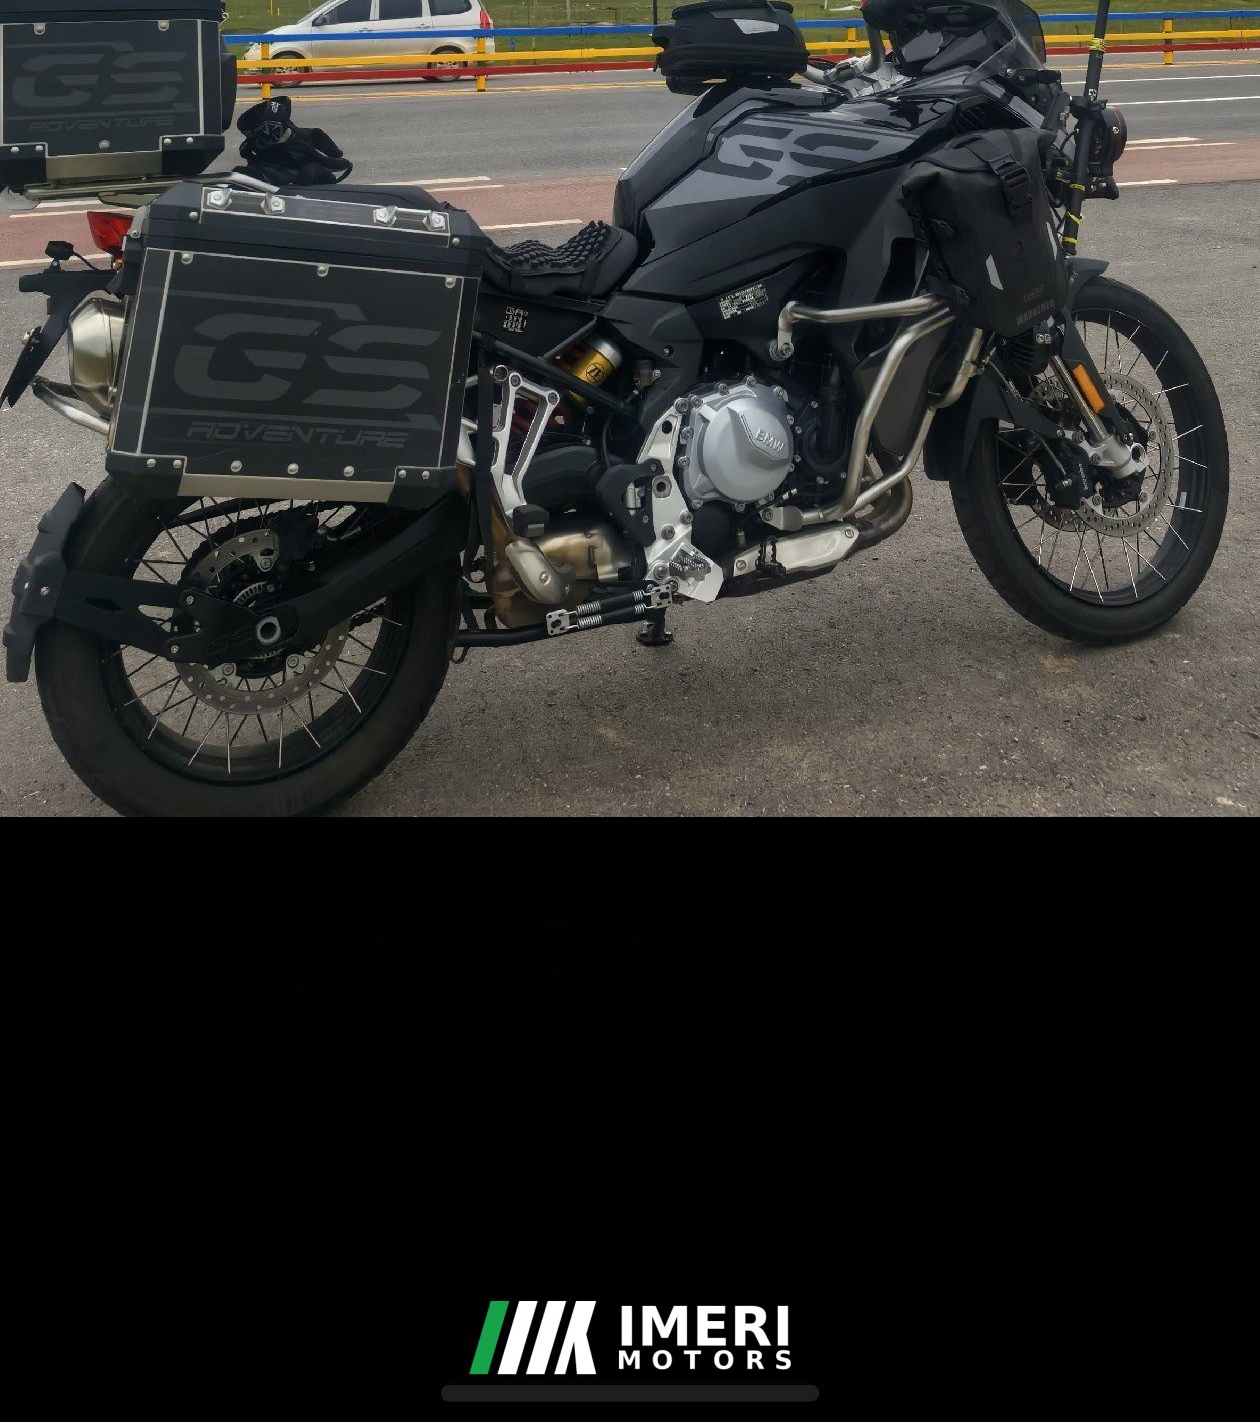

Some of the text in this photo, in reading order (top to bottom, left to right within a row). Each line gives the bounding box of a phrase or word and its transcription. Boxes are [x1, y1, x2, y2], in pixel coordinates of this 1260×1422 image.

[12, 51, 187, 108] GS
[28, 114, 176, 132] ADVENTURE
[174, 313, 442, 410] GS
[187, 421, 410, 449] ADVENTURE
[755, 428, 784, 452] BMW
